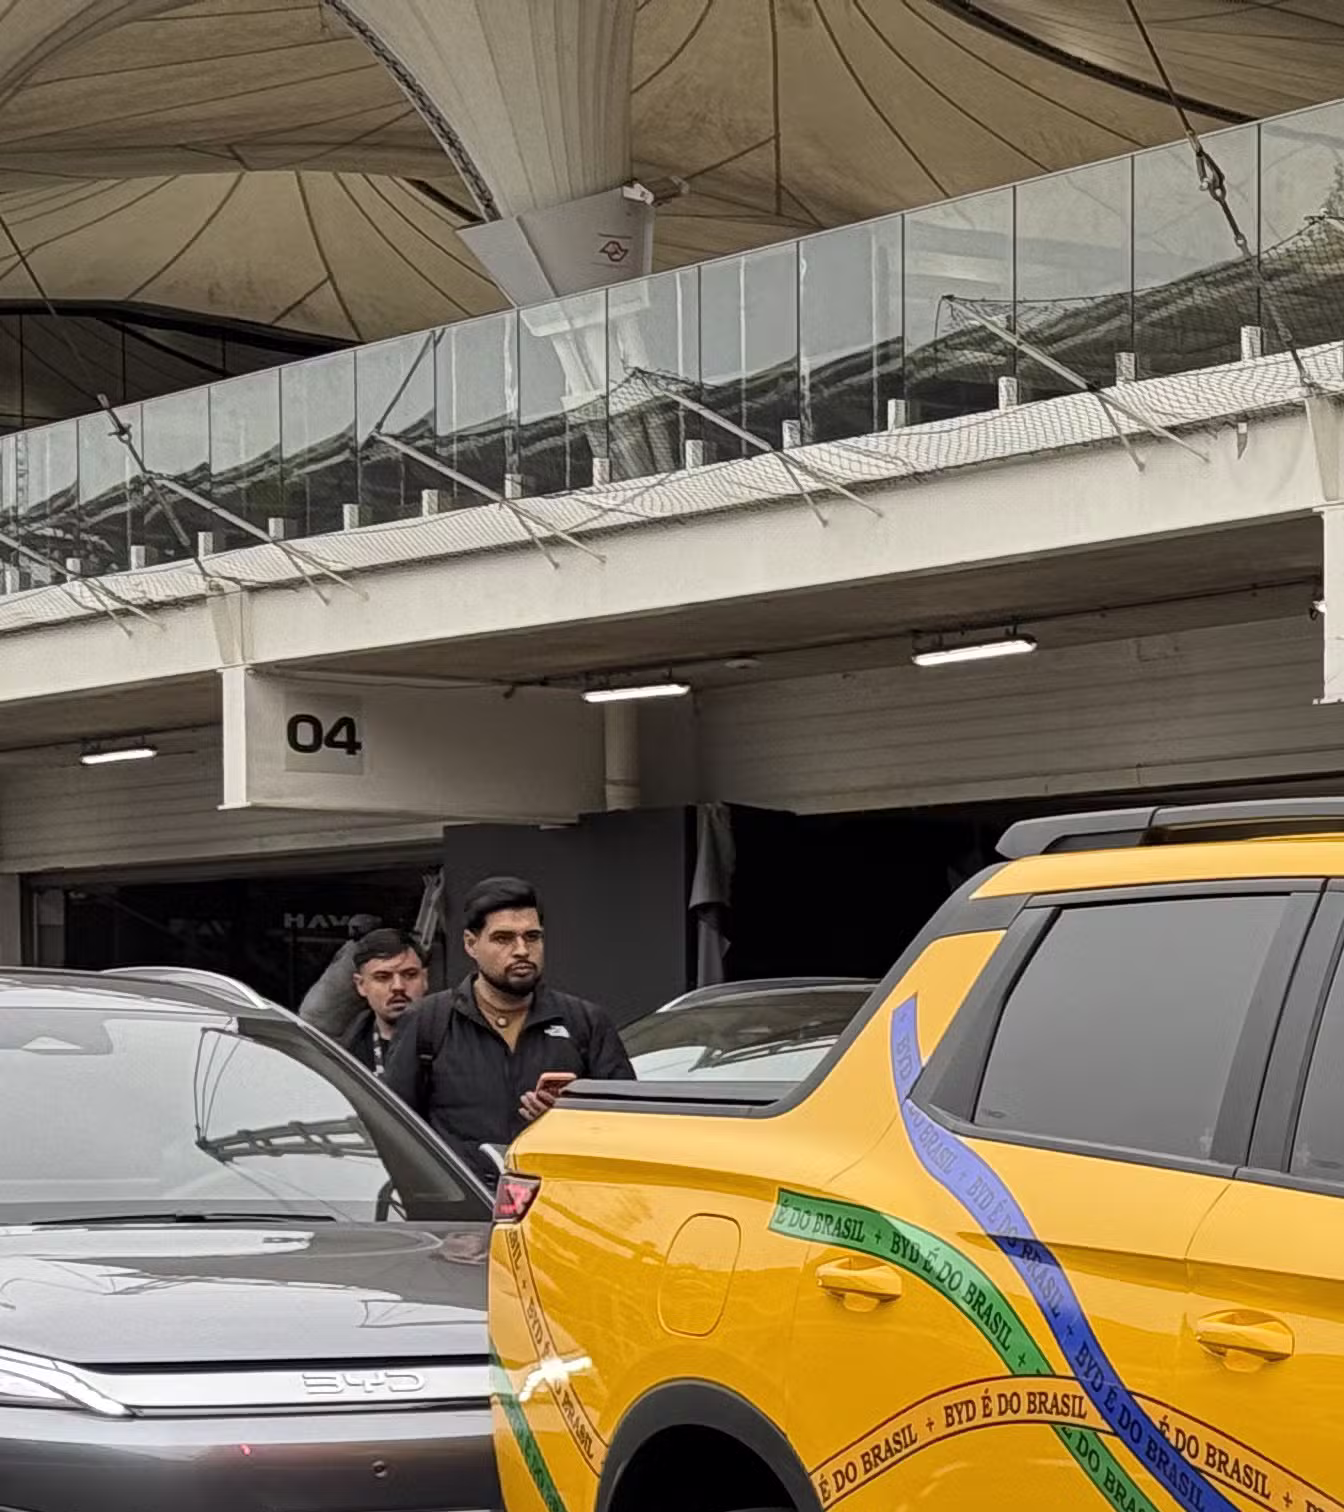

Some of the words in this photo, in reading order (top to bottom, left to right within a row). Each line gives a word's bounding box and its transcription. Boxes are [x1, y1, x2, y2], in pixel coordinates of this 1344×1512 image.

[286, 713, 362, 756] 04
[812, 1211, 865, 1243] BRASIL
[889, 1229, 920, 1264] BYD
[918, 1246, 940, 1274] É
[933, 1260, 963, 1292] DO
[962, 1281, 1011, 1351] BRASIL
[831, 1460, 858, 1491] DO
[860, 1423, 919, 1471] BRASIL
[943, 1398, 976, 1428] BYD
[980, 1387, 993, 1419] É
[996, 1390, 1021, 1416] DO
[1026, 1390, 1090, 1419] BRASIL
[1074, 1340, 1105, 1392] BYD
[1102, 1385, 1123, 1414] É
[1117, 1406, 1143, 1444] DO
[1144, 1437, 1205, 1512] BRASIL
[1074, 1433, 1100, 1473] DO
[1174, 1427, 1200, 1460] DO
[1205, 1442, 1271, 1499] BRASIL
